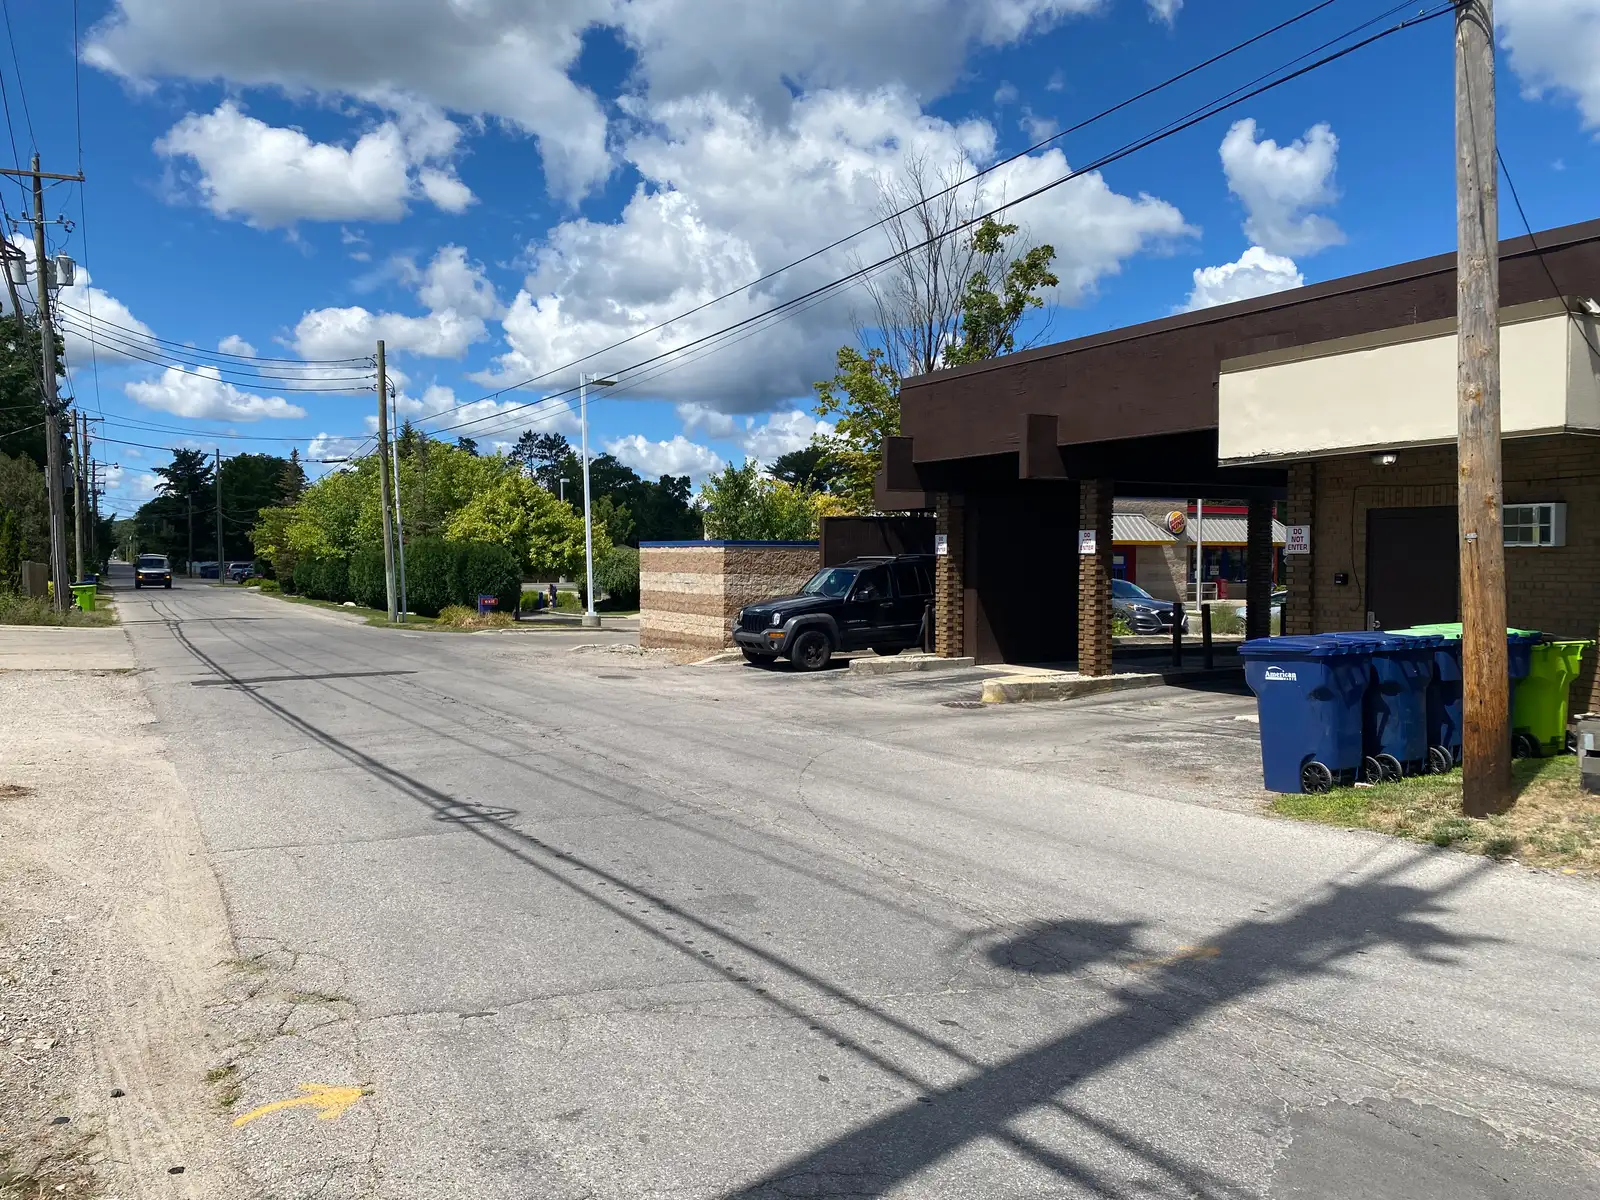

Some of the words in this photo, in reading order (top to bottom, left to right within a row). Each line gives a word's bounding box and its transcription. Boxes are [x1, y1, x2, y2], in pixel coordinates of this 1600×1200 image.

[1170, 513, 1184, 525] BURGER
[1170, 517, 1185, 532] KING
[1265, 670, 1297, 678] American
